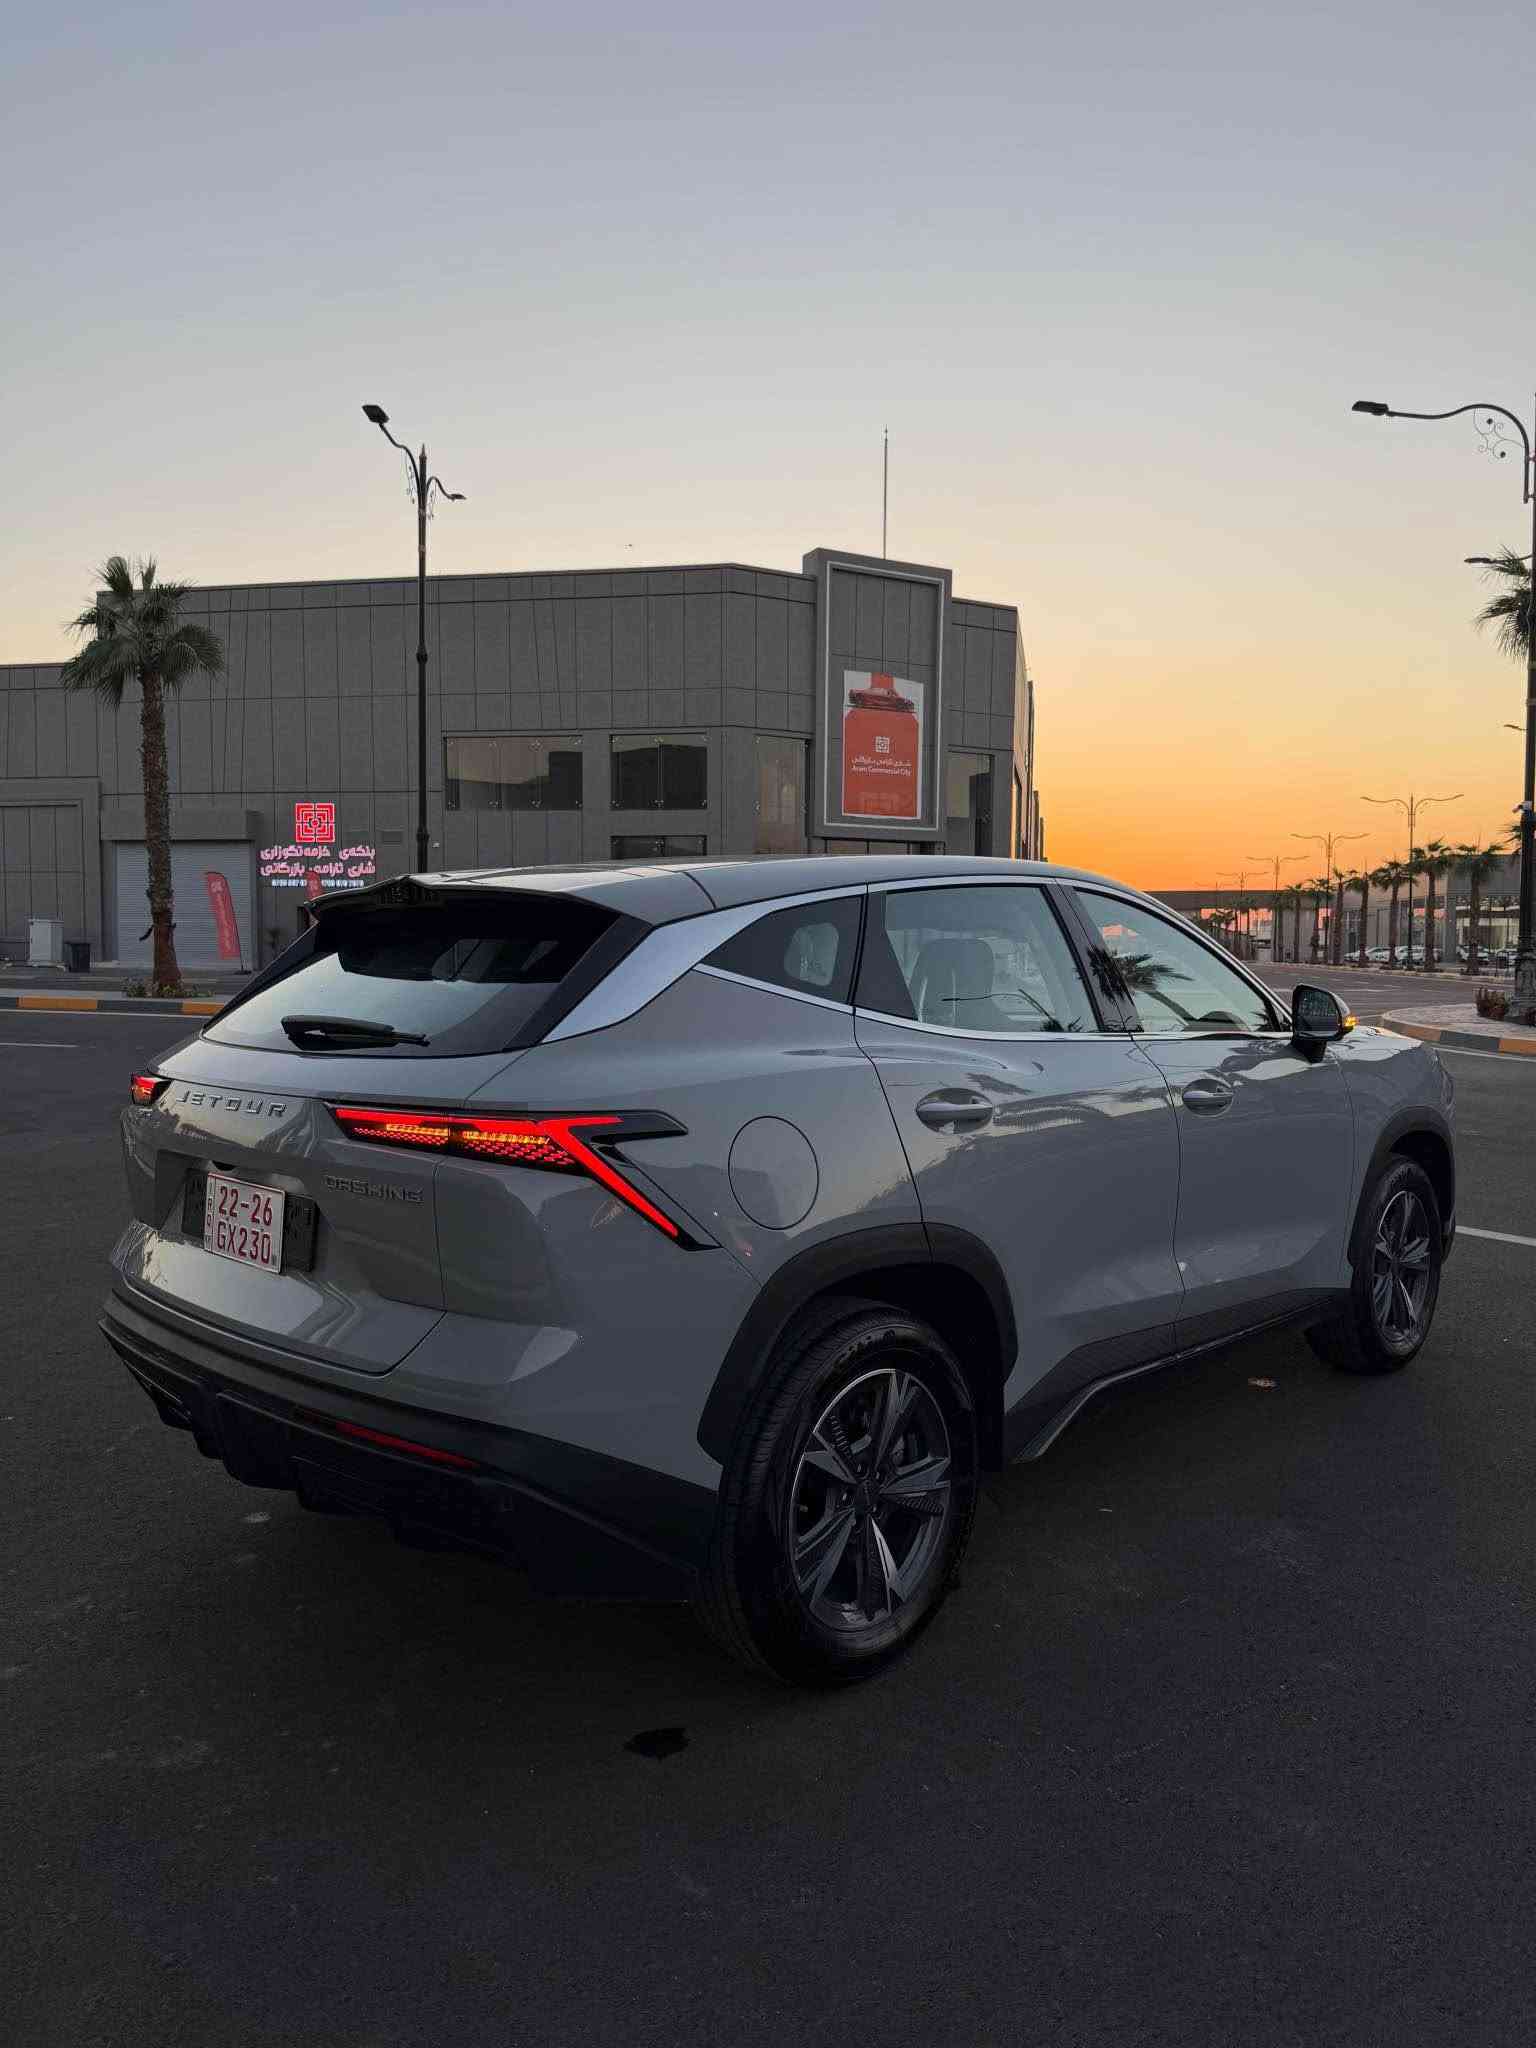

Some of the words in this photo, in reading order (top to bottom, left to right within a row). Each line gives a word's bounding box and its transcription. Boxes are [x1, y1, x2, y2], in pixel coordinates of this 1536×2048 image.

[900, 767, 912, 777] City
[176, 1090, 287, 1118] JETOUR
[218, 1185, 273, 1227] 22-26
[217, 1220, 271, 1264] GX230
